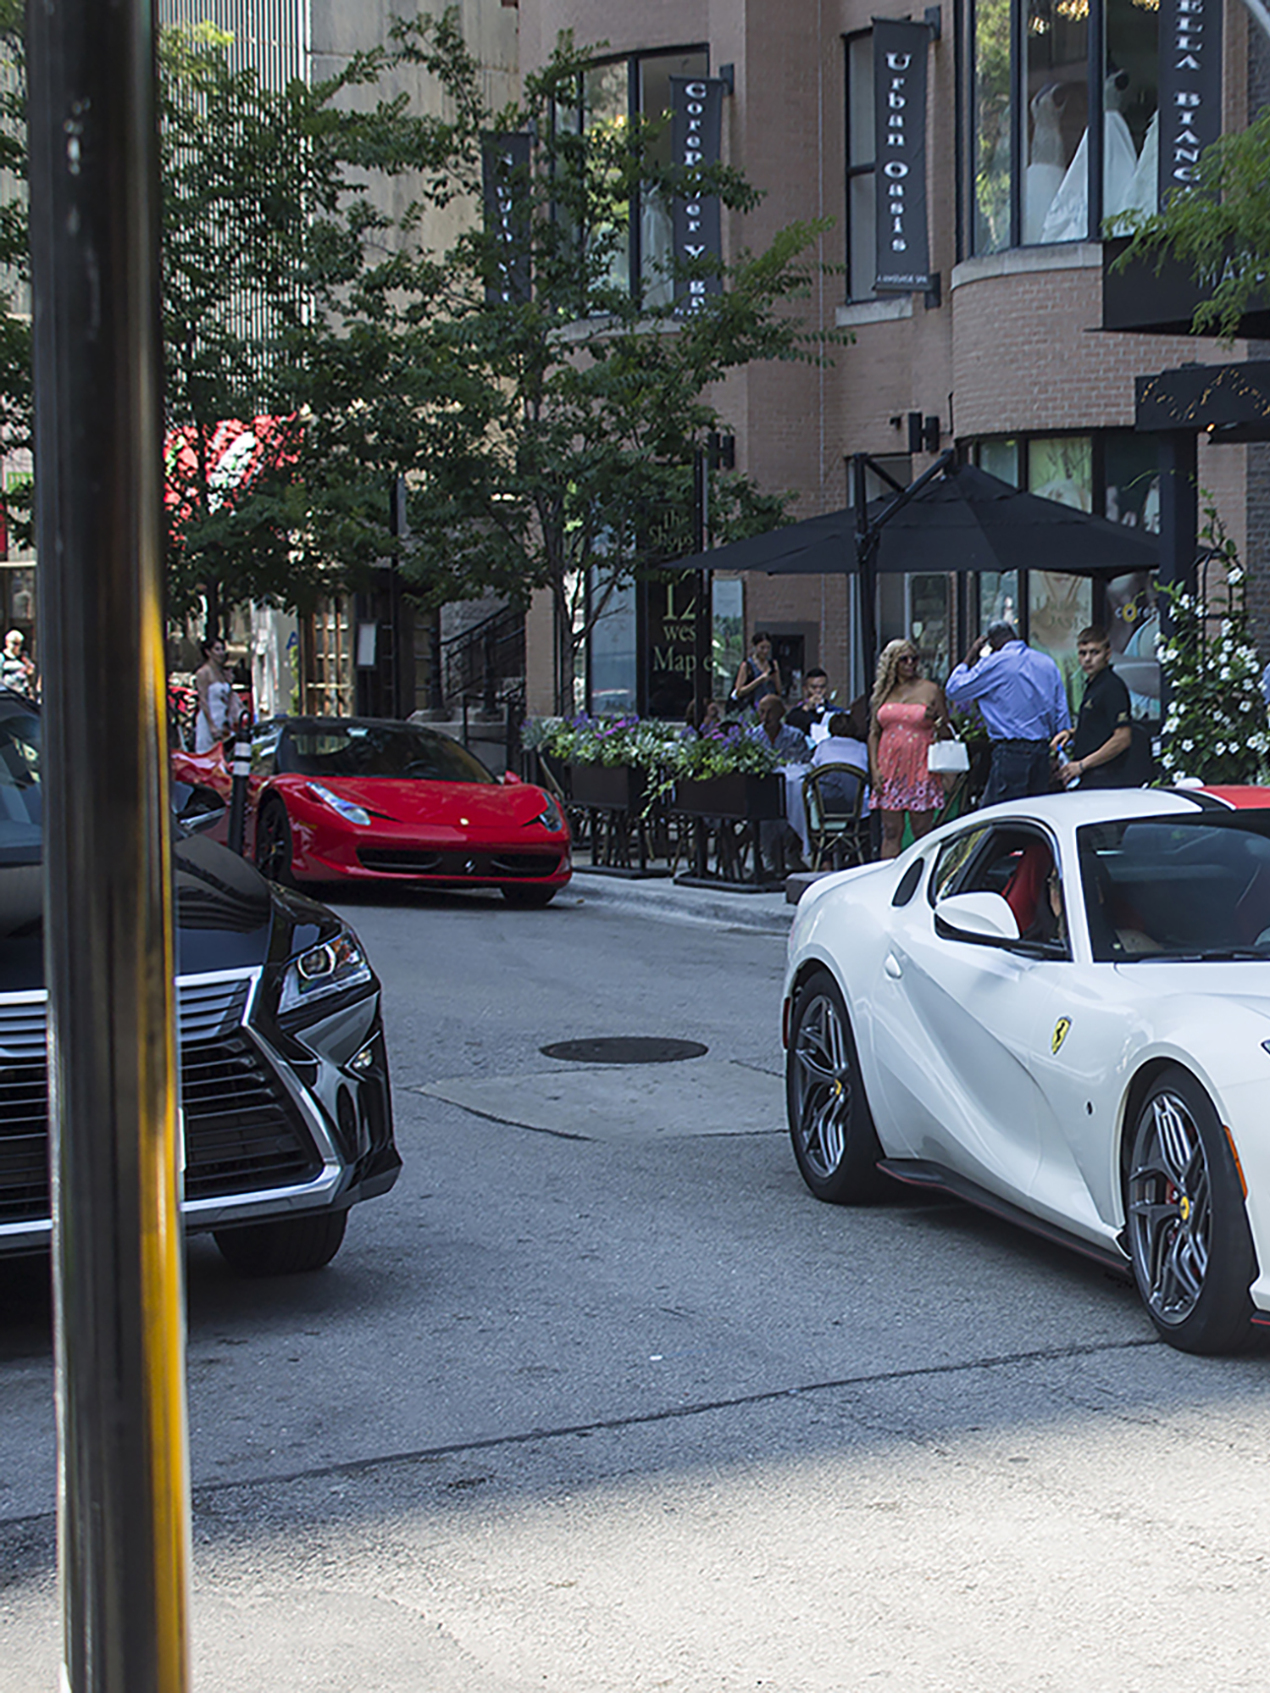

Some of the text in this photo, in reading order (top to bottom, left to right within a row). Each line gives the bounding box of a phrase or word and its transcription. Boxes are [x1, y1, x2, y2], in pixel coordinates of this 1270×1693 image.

[884, 53, 911, 251] Urban Oasis
[663, 625, 697, 642] wes
[653, 646, 713, 680] Mape
